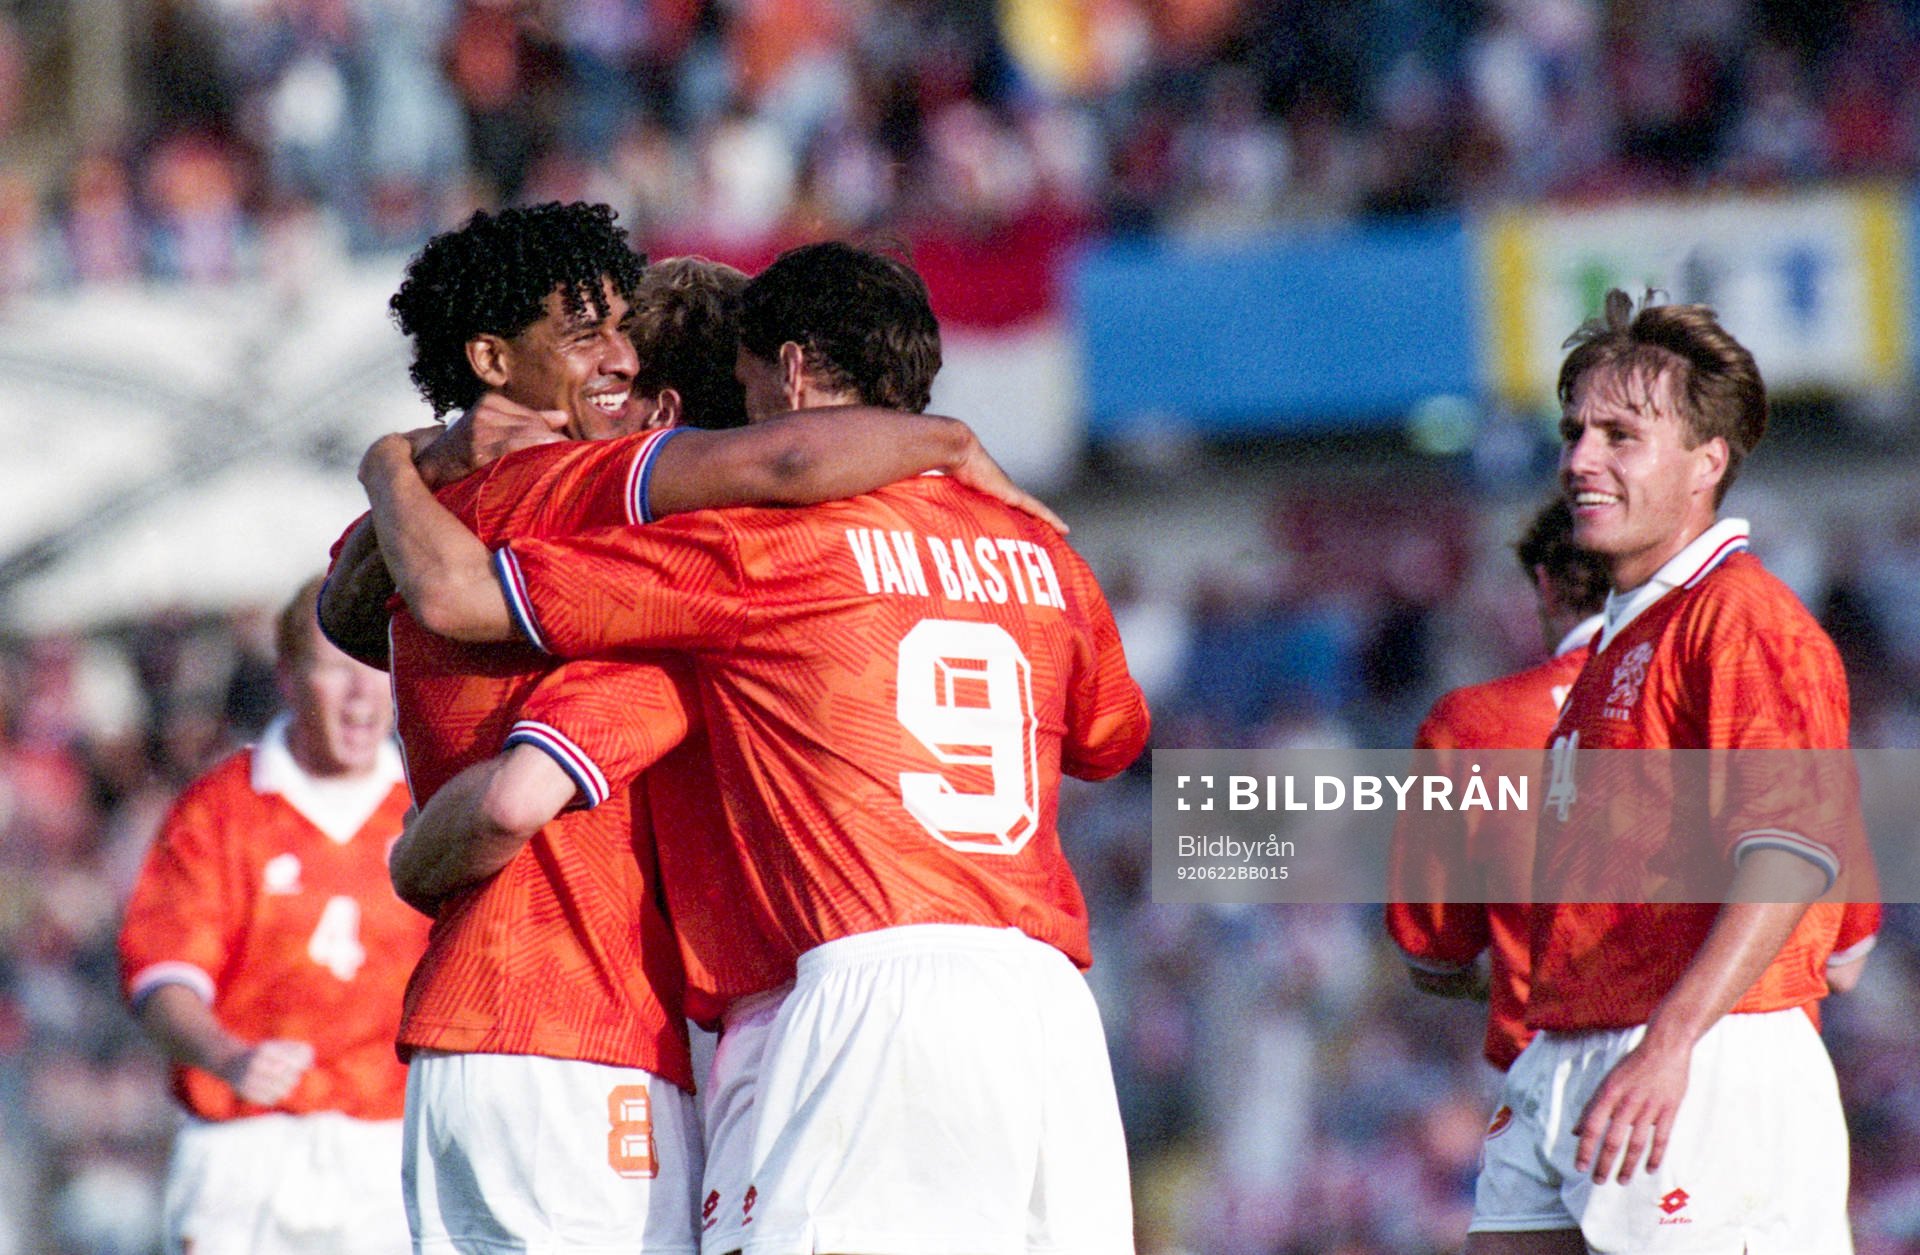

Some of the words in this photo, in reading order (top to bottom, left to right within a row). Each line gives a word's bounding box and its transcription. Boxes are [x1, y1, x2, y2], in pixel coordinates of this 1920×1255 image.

[846, 529, 929, 597] VAN
[927, 535, 1067, 611] BASTEN
[896, 618, 1039, 855] 9
[308, 896, 367, 981] 4
[608, 1085, 660, 1180] 8
